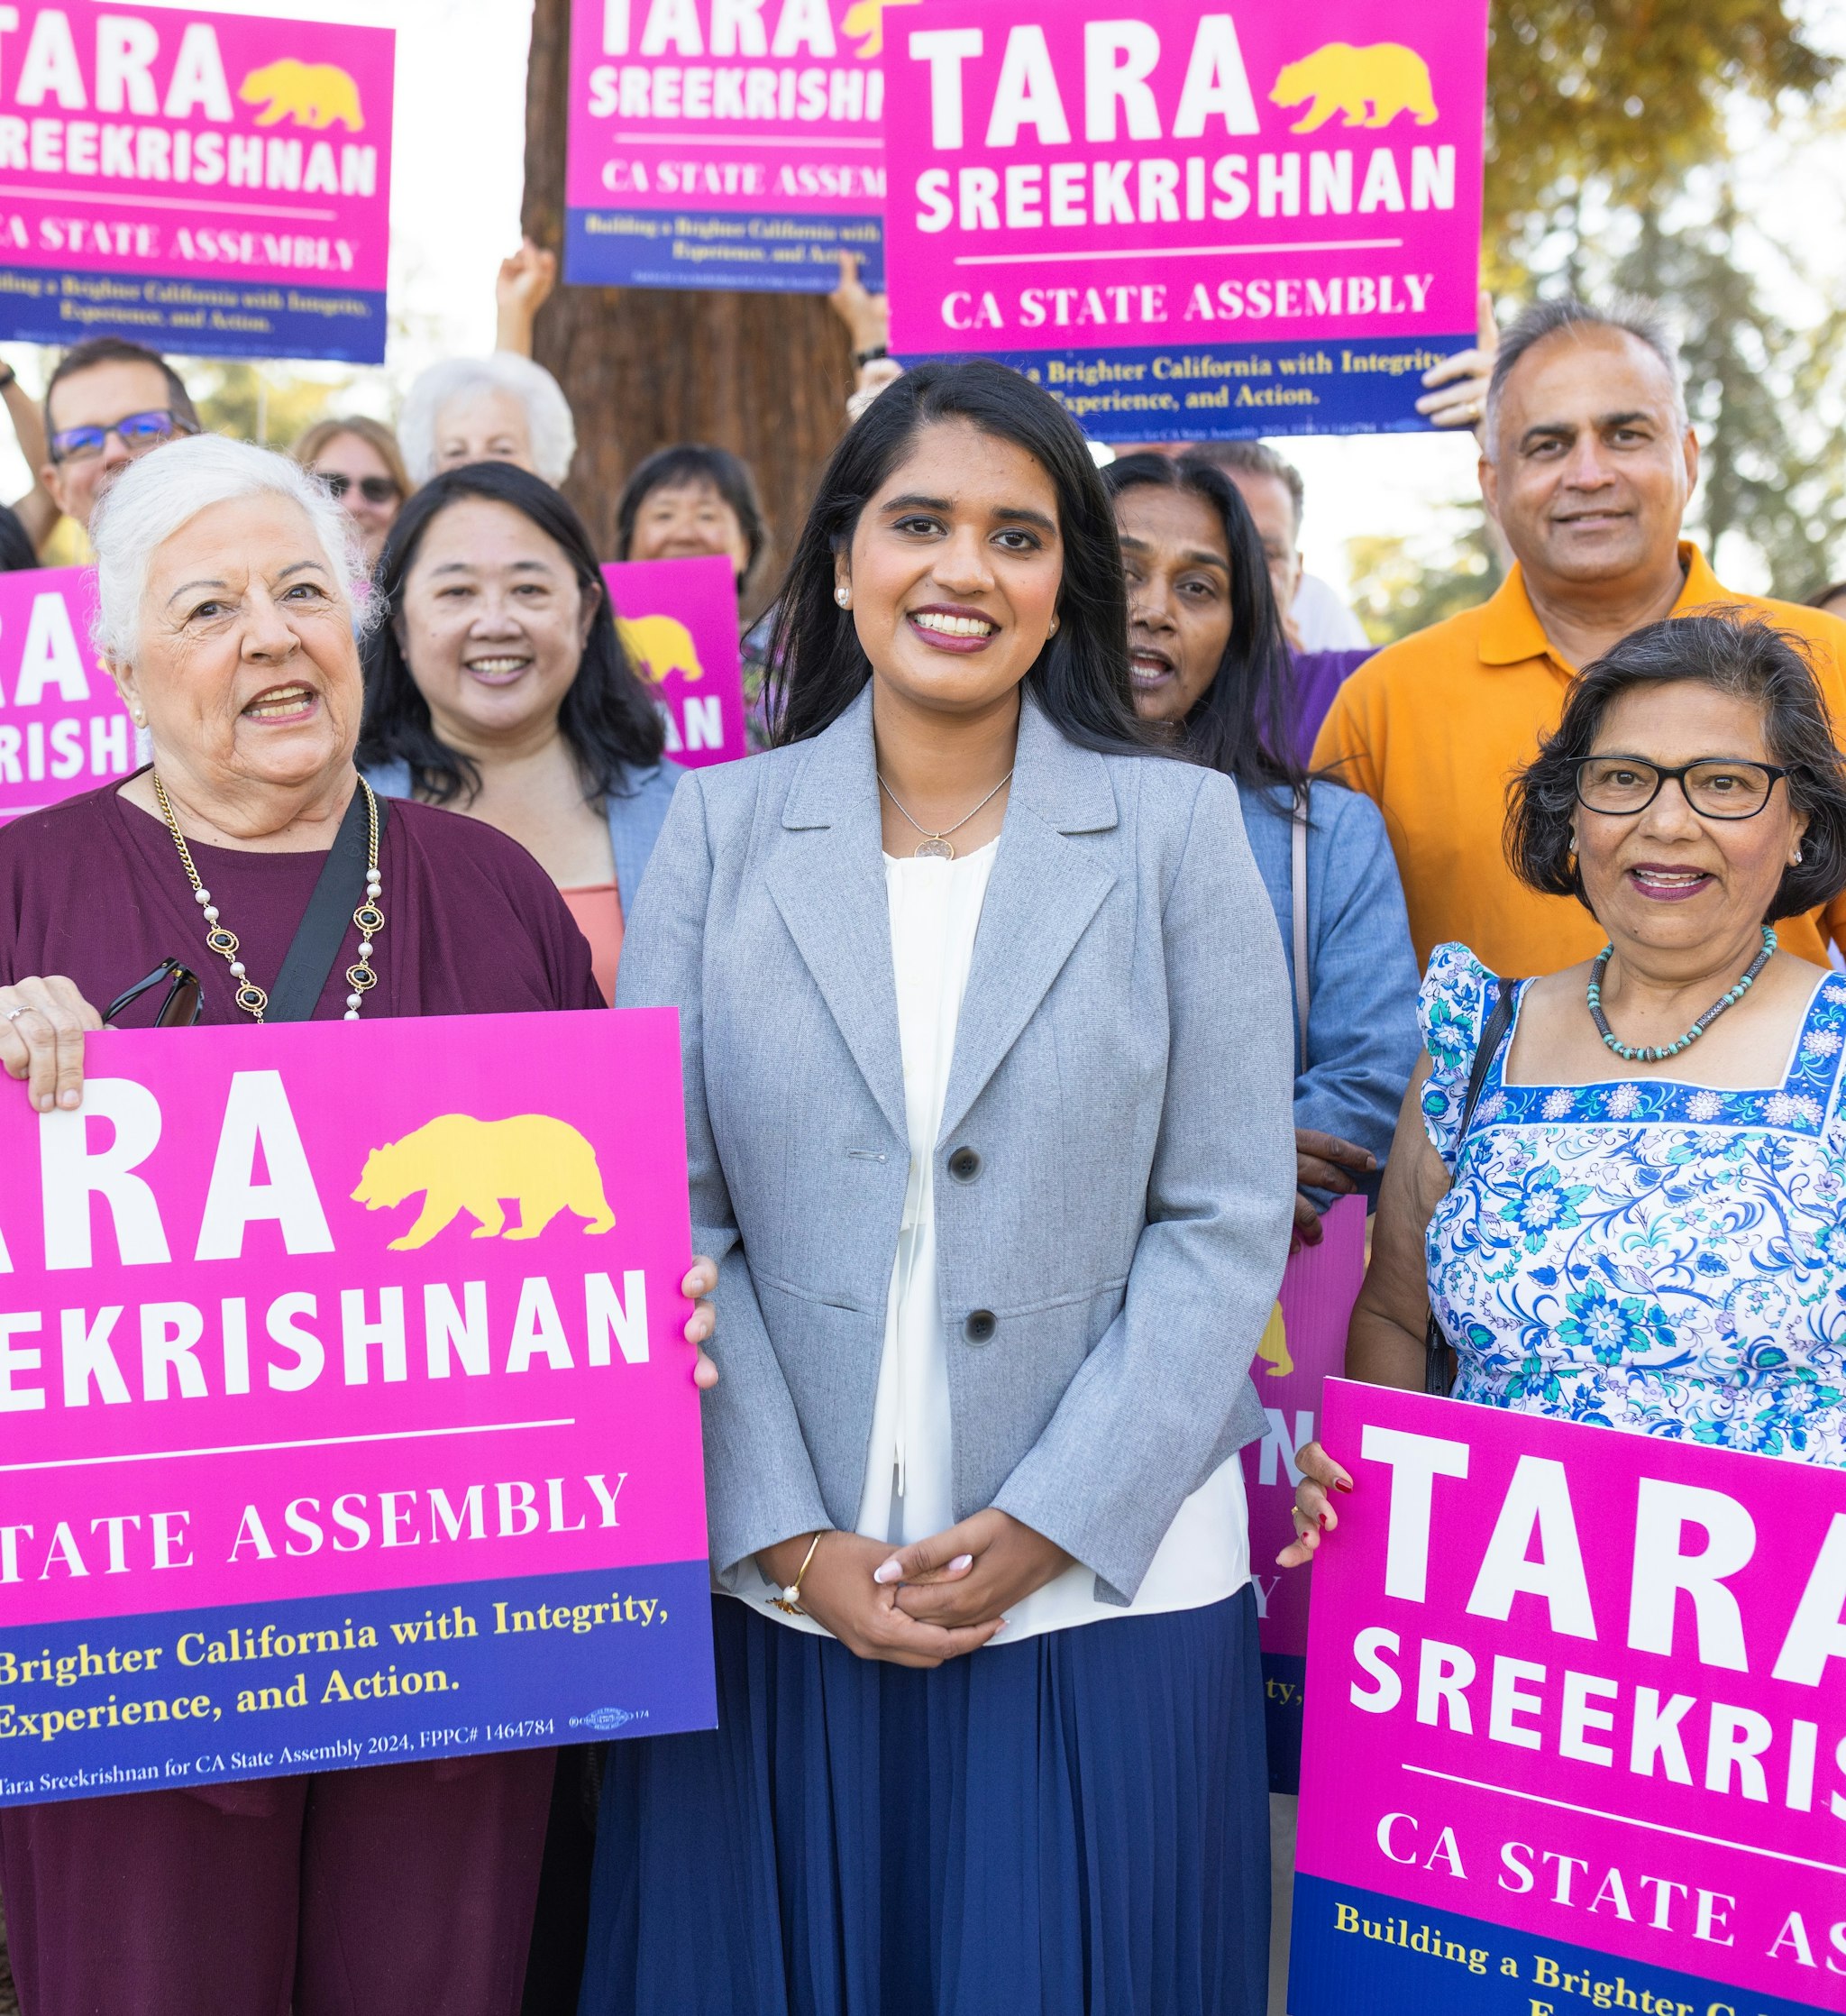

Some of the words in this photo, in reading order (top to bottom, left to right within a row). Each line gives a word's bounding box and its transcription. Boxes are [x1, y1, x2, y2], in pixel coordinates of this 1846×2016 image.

[909, 14, 1261, 150] TARA
[601, 158, 649, 193] CA
[655, 160, 765, 196] STATE
[916, 144, 1456, 233] SREEKRISHNAN
[0, 215, 30, 250] A
[39, 216, 160, 258] STATE
[169, 227, 359, 271] ASSEMBLY
[748, 218, 836, 242] California
[840, 222, 881, 243] with
[772, 244, 806, 261] and
[144, 280, 240, 307] California
[242, 289, 285, 311] with
[169, 309, 205, 327] and
[940, 289, 1003, 330] CA
[1019, 284, 1169, 328] STATE
[1183, 273, 1435, 322] ASSEMBLY
[1047, 360, 1147, 387] Brighter
[1152, 352, 1273, 380] California
[1279, 348, 1333, 375] with
[1185, 387, 1229, 409] and
[1235, 384, 1321, 408] Action.
[0, 591, 90, 707] A
[0, 1069, 336, 1275] RA
[0, 1269, 650, 1412] EKRISHNAN
[1240, 1407, 1314, 1488] N
[226, 1472, 628, 1563] ASSEMBLY
[0, 1644, 162, 1687] Brighter
[177, 1618, 378, 1667] California
[389, 1606, 480, 1645] with
[492, 1592, 668, 1634] Integrity,
[0, 1695, 223, 1741] Experience,
[236, 1673, 308, 1713] and
[321, 1665, 460, 1702] Action.
[1349, 1626, 1846, 1823] SREEKRI
[40, 1758, 159, 1791] Sreekrishnan
[165, 1758, 191, 1777] for
[196, 1755, 225, 1773] CA
[231, 1751, 274, 1769] State
[279, 1738, 362, 1764] Assembly
[368, 1734, 415, 1754] 2024,
[419, 1727, 479, 1748] FPPC#
[485, 1718, 555, 1741] 1464784
[1375, 1811, 1469, 1880] CA
[1497, 1841, 1736, 1947] STATE
[1334, 1902, 1489, 1975] Building
[1500, 1954, 1519, 1978] a
[1531, 1955, 1694, 2016] Brighter
